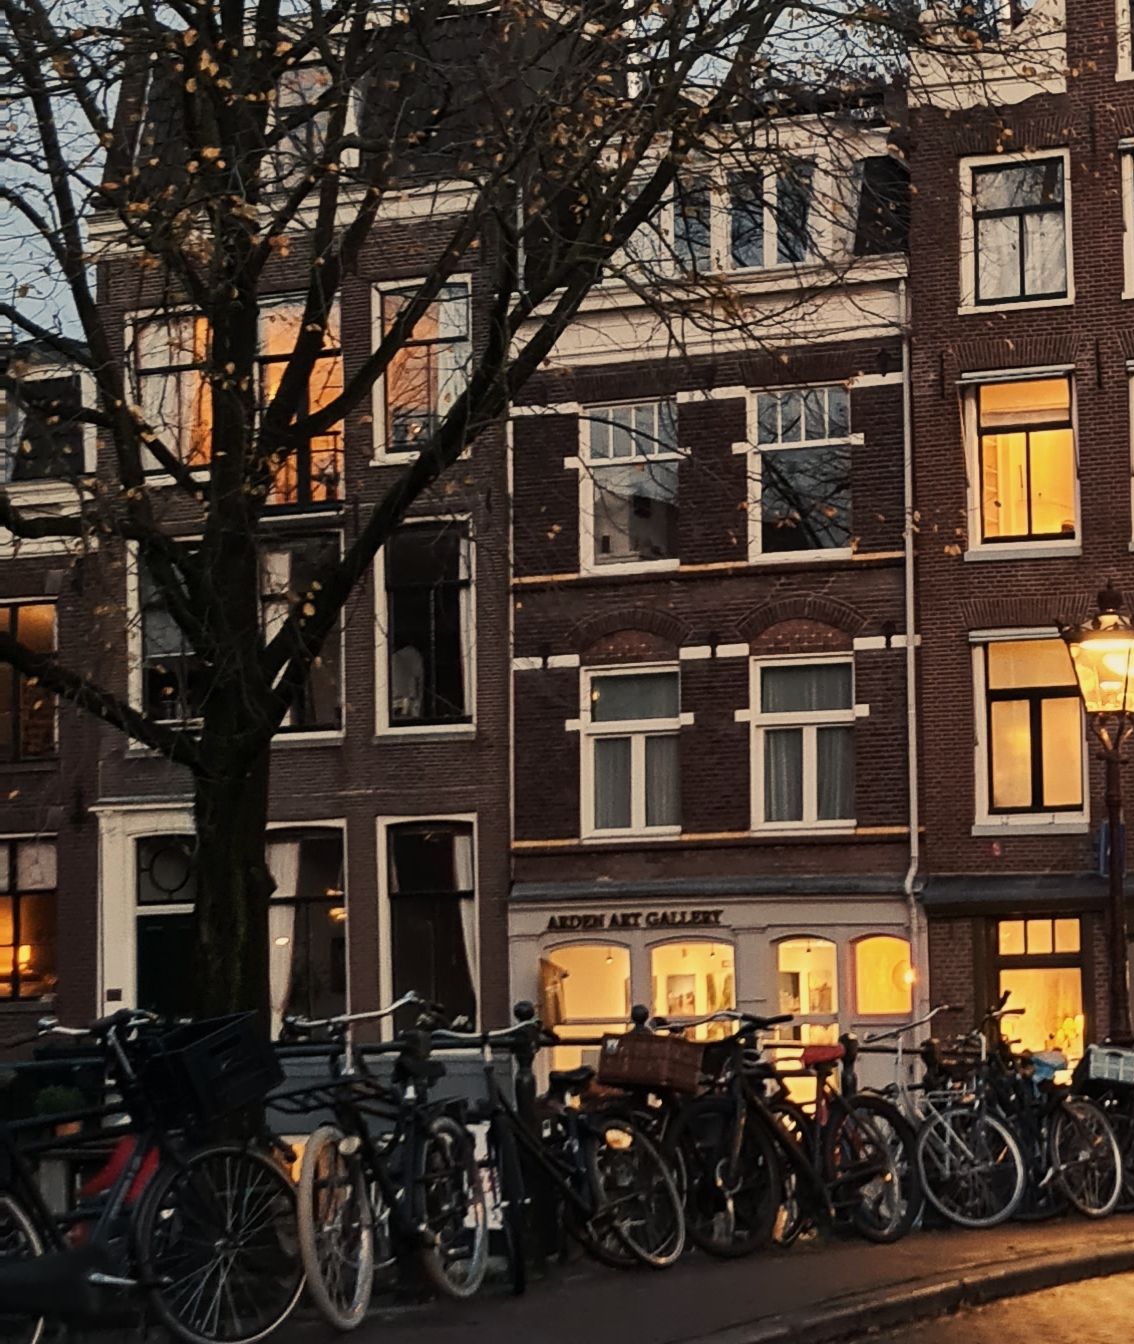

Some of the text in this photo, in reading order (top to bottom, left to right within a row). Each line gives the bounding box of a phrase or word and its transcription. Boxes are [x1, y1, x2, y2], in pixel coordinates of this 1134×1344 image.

[547, 909, 723, 930] ARDEN ART GALLERY
